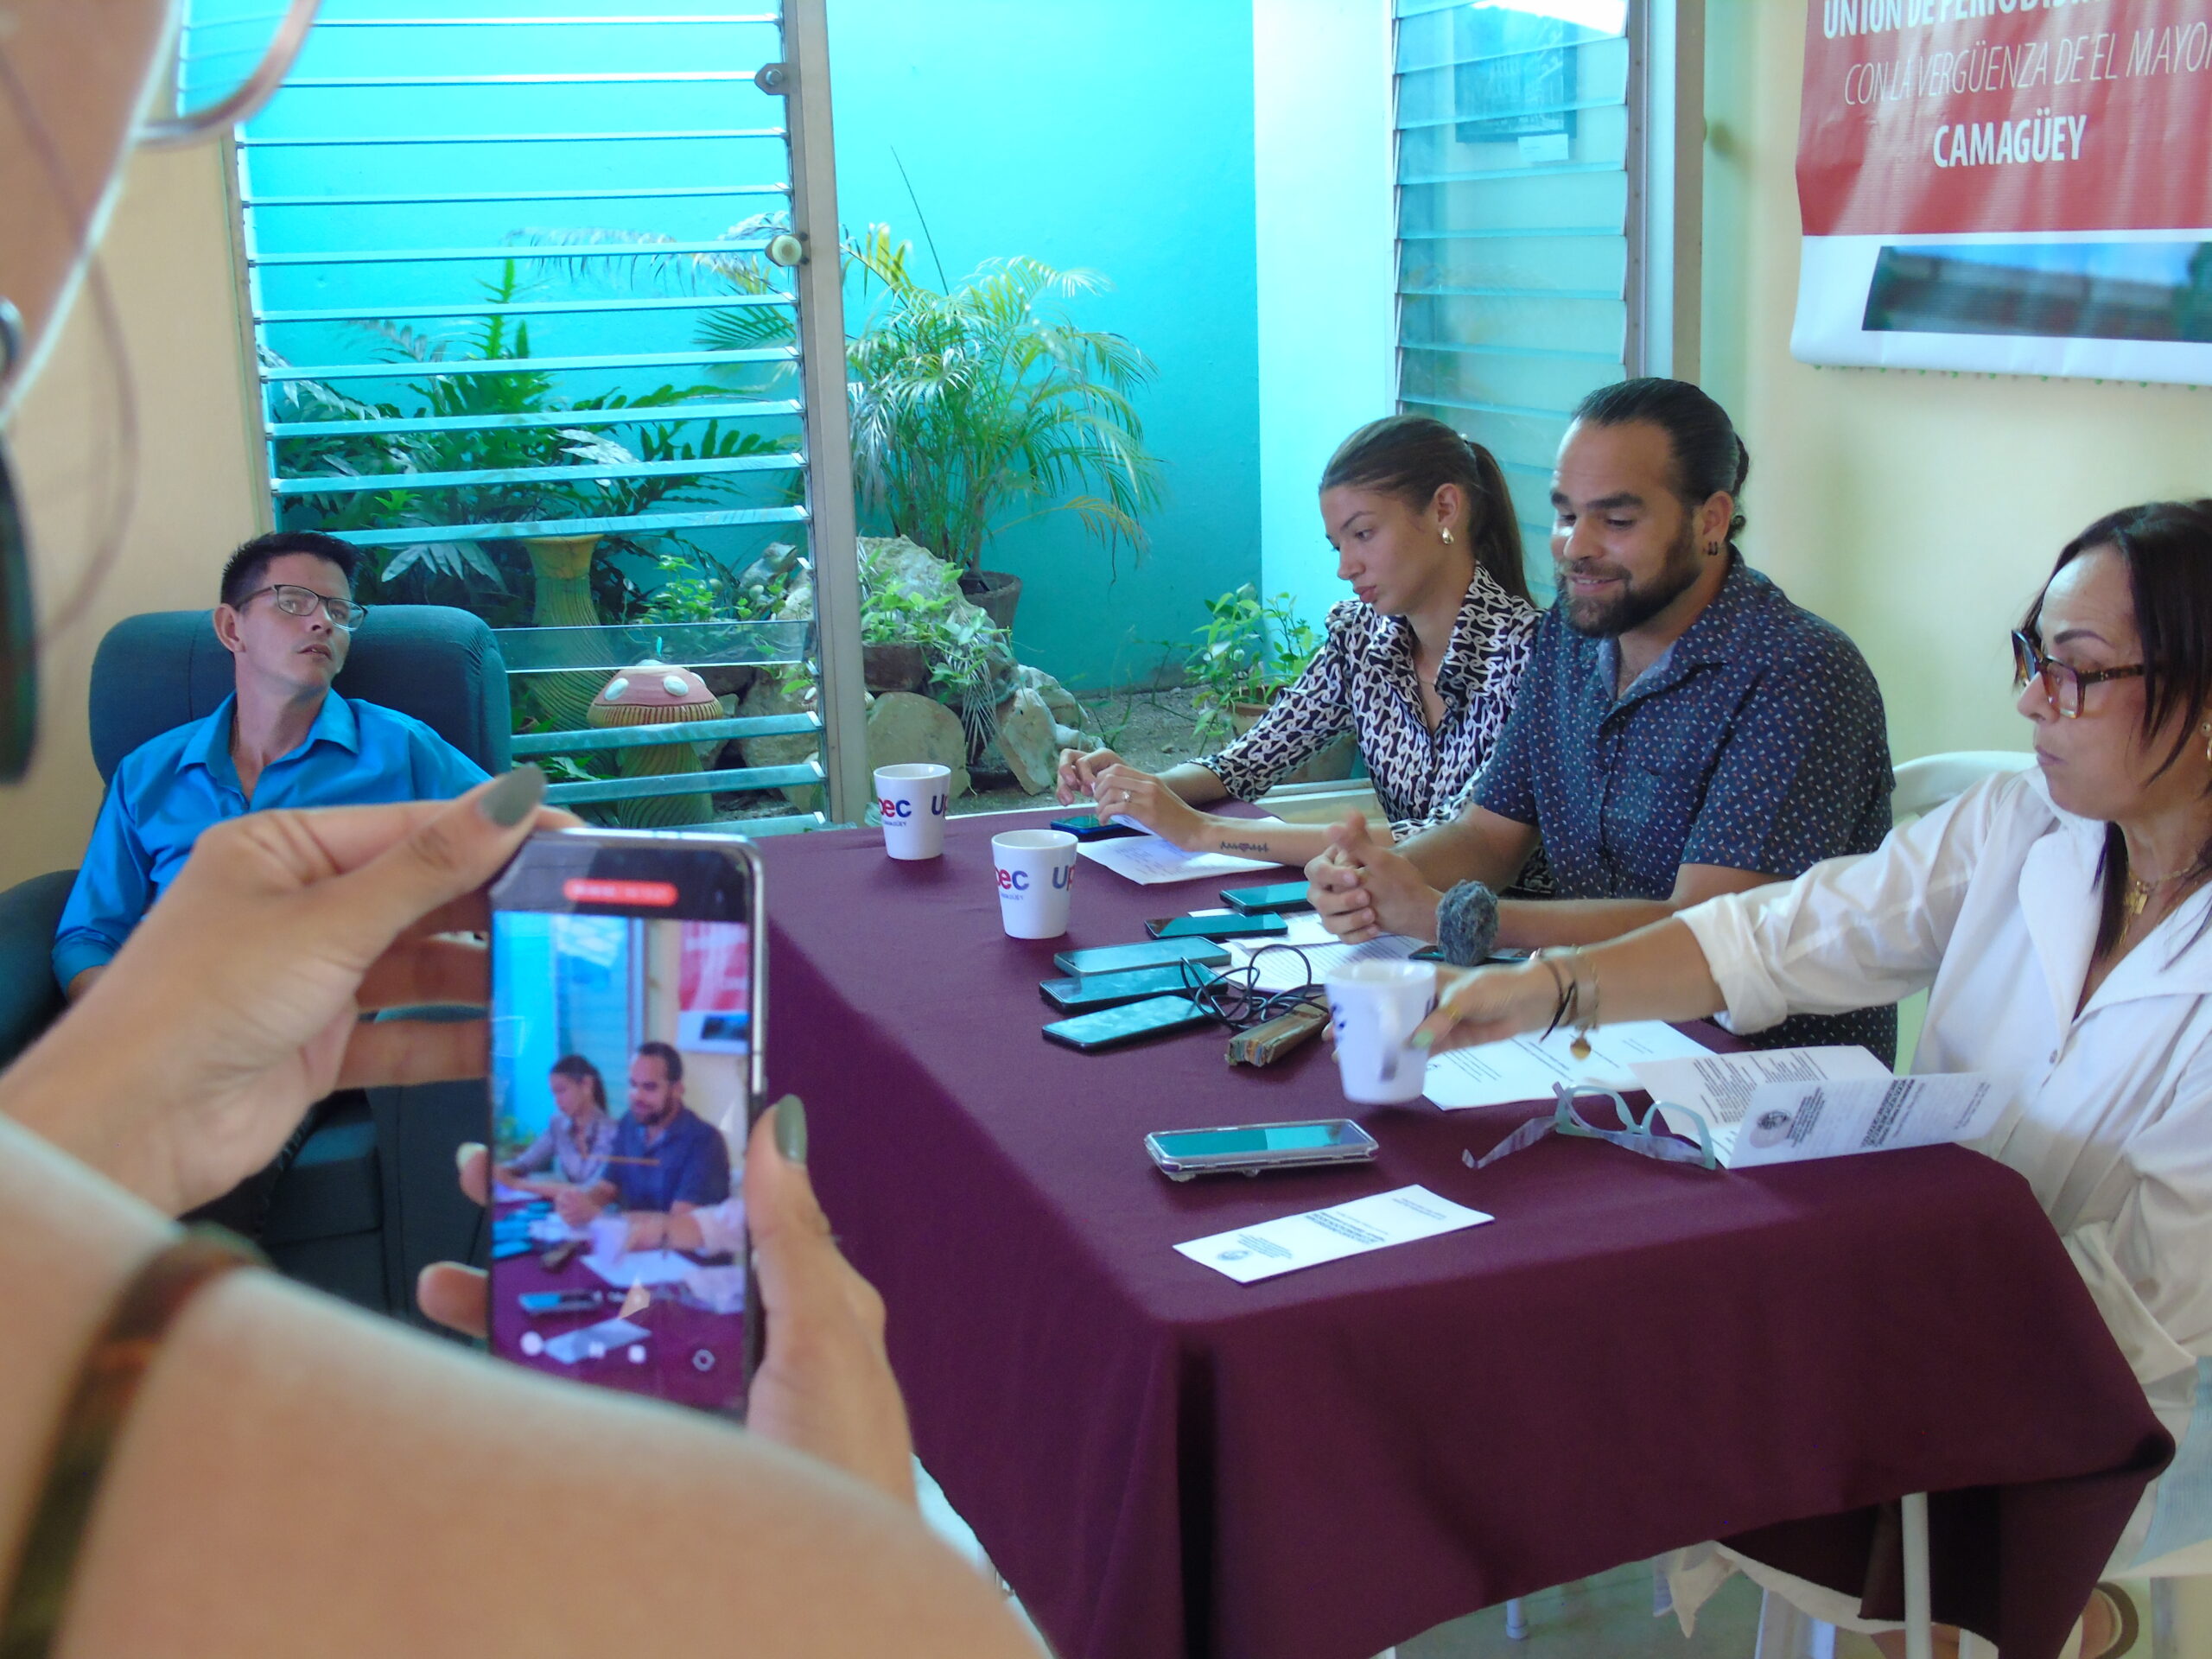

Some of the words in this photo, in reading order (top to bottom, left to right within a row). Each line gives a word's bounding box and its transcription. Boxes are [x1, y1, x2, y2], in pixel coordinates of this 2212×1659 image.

[1845, 61, 1889, 105] CON
[1890, 57, 1911, 100] LA
[1918, 40, 2049, 97] VERGÜENZA
[2054, 35, 2089, 85] DE
[2090, 33, 2117, 80] EL
[2126, 22, 2212, 77] MAYO
[1933, 107, 2088, 168] CAMAGÜEY
